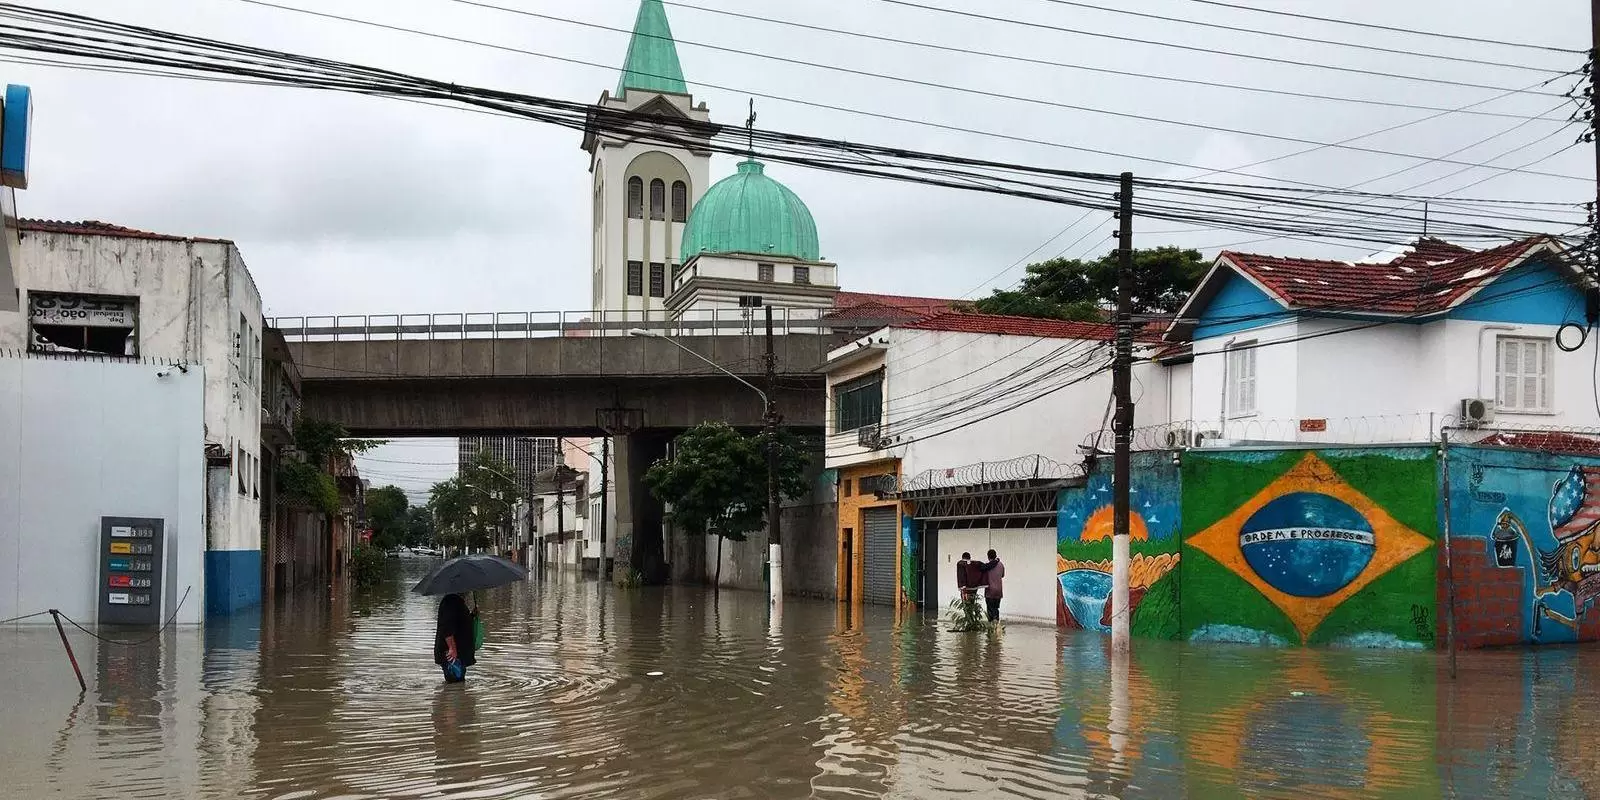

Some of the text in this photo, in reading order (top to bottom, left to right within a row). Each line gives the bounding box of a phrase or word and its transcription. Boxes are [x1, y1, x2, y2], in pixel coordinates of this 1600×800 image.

[1245, 530, 1363, 543] ORDEM E PROGRESSO
